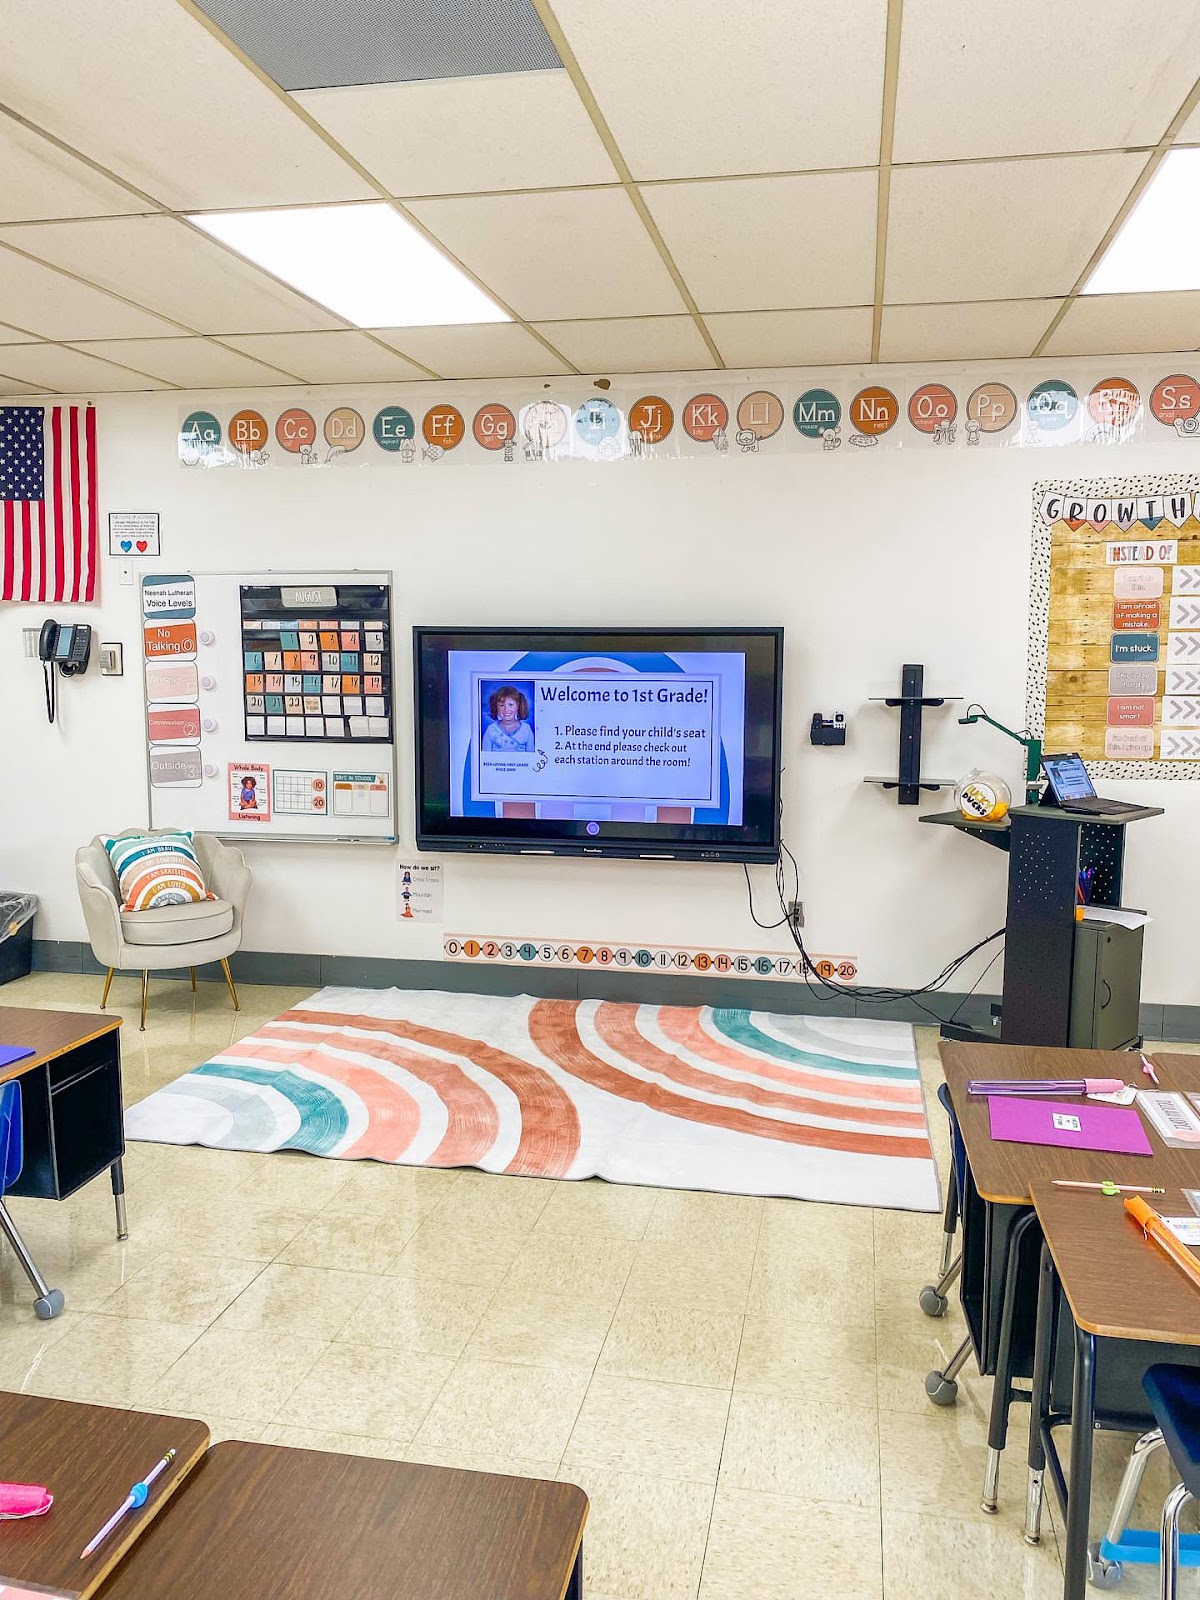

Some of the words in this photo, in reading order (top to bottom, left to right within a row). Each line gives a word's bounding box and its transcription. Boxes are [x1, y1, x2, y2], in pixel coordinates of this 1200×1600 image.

[236, 420, 261, 440] Bb
[284, 418, 308, 438] Cc
[332, 417, 356, 438] Dd
[382, 416, 406, 437] Ee
[432, 415, 455, 436] Ff
[481, 415, 508, 440] Gg
[640, 405, 662, 432] Jj
[692, 404, 720, 426] Kk
[799, 402, 836, 422] Mm
[860, 398, 889, 421] Nn
[917, 396, 948, 417] Oo
[978, 395, 1006, 422] Pp
[1161, 386, 1192, 409] Ss
[1046, 497, 1186, 523] GROWTH
[1109, 545, 1154, 562] INSTEAD
[168, 599, 193, 607] Levels
[295, 590, 322, 604] AUGUST
[1125, 612, 1151, 620] making
[157, 629, 171, 638] No
[308, 635, 314, 644] 2
[330, 634, 335, 643] 3
[350, 633, 356, 644] 4
[375, 634, 382, 645] 5
[146, 641, 181, 653] Talking
[309, 654, 315, 666] 9
[328, 654, 338, 665] 10
[349, 654, 357, 665] 11
[369, 655, 380, 666] 12
[253, 676, 262, 686] 13
[272, 676, 281, 687] 14
[291, 677, 300, 688] 15
[331, 677, 339, 688] 17
[370, 678, 380, 689] 19
[540, 685, 610, 702] Welcome
[614, 689, 629, 703] to
[632, 688, 654, 702] 1st
[657, 687, 708, 703] Grade!
[250, 696, 262, 707] 20
[288, 697, 300, 708] 22
[187, 724, 194, 736] 2
[554, 726, 563, 736] 1.
[565, 725, 597, 736] Please
[600, 725, 620, 737] find
[622, 728, 646, 739] your
[648, 726, 681, 738] child's
[683, 728, 706, 738] seat
[554, 741, 563, 750] 2.
[565, 741, 576, 750] At
[578, 741, 593, 751] the
[594, 741, 611, 751] end
[613, 742, 642, 754] please
[643, 742, 670, 752] check
[671, 743, 687, 753] out
[151, 761, 186, 770] Outside
[554, 755, 576, 764] each
[577, 755, 609, 765] station
[611, 756, 643, 766] around
[646, 756, 661, 766] the
[662, 757, 691, 767] room!
[188, 766, 195, 778] 3
[315, 781, 323, 789] 10
[314, 799, 324, 807] 20
[966, 785, 993, 809] LUCKY
[962, 792, 987, 815] DUCKS
[238, 813, 261, 821] Listening
[157, 882, 166, 890] AM
[449, 941, 457, 954] 0
[487, 944, 495, 955] 2
[505, 945, 512, 957] 3
[523, 946, 531, 958] 4
[543, 947, 551, 959] 5
[561, 948, 569, 960] 6
[581, 949, 589, 961] 7
[601, 950, 608, 962] 8
[619, 952, 627, 963] 9
[638, 953, 649, 964] 10
[660, 954, 666, 966] 11
[678, 954, 688, 966] 12
[698, 956, 708, 968] 13
[718, 957, 728, 969] 14
[738, 958, 748, 971] 15
[758, 960, 769, 972] 16
[779, 961, 790, 973] 17
[820, 963, 832, 975] 19
[840, 965, 854, 976] 20
